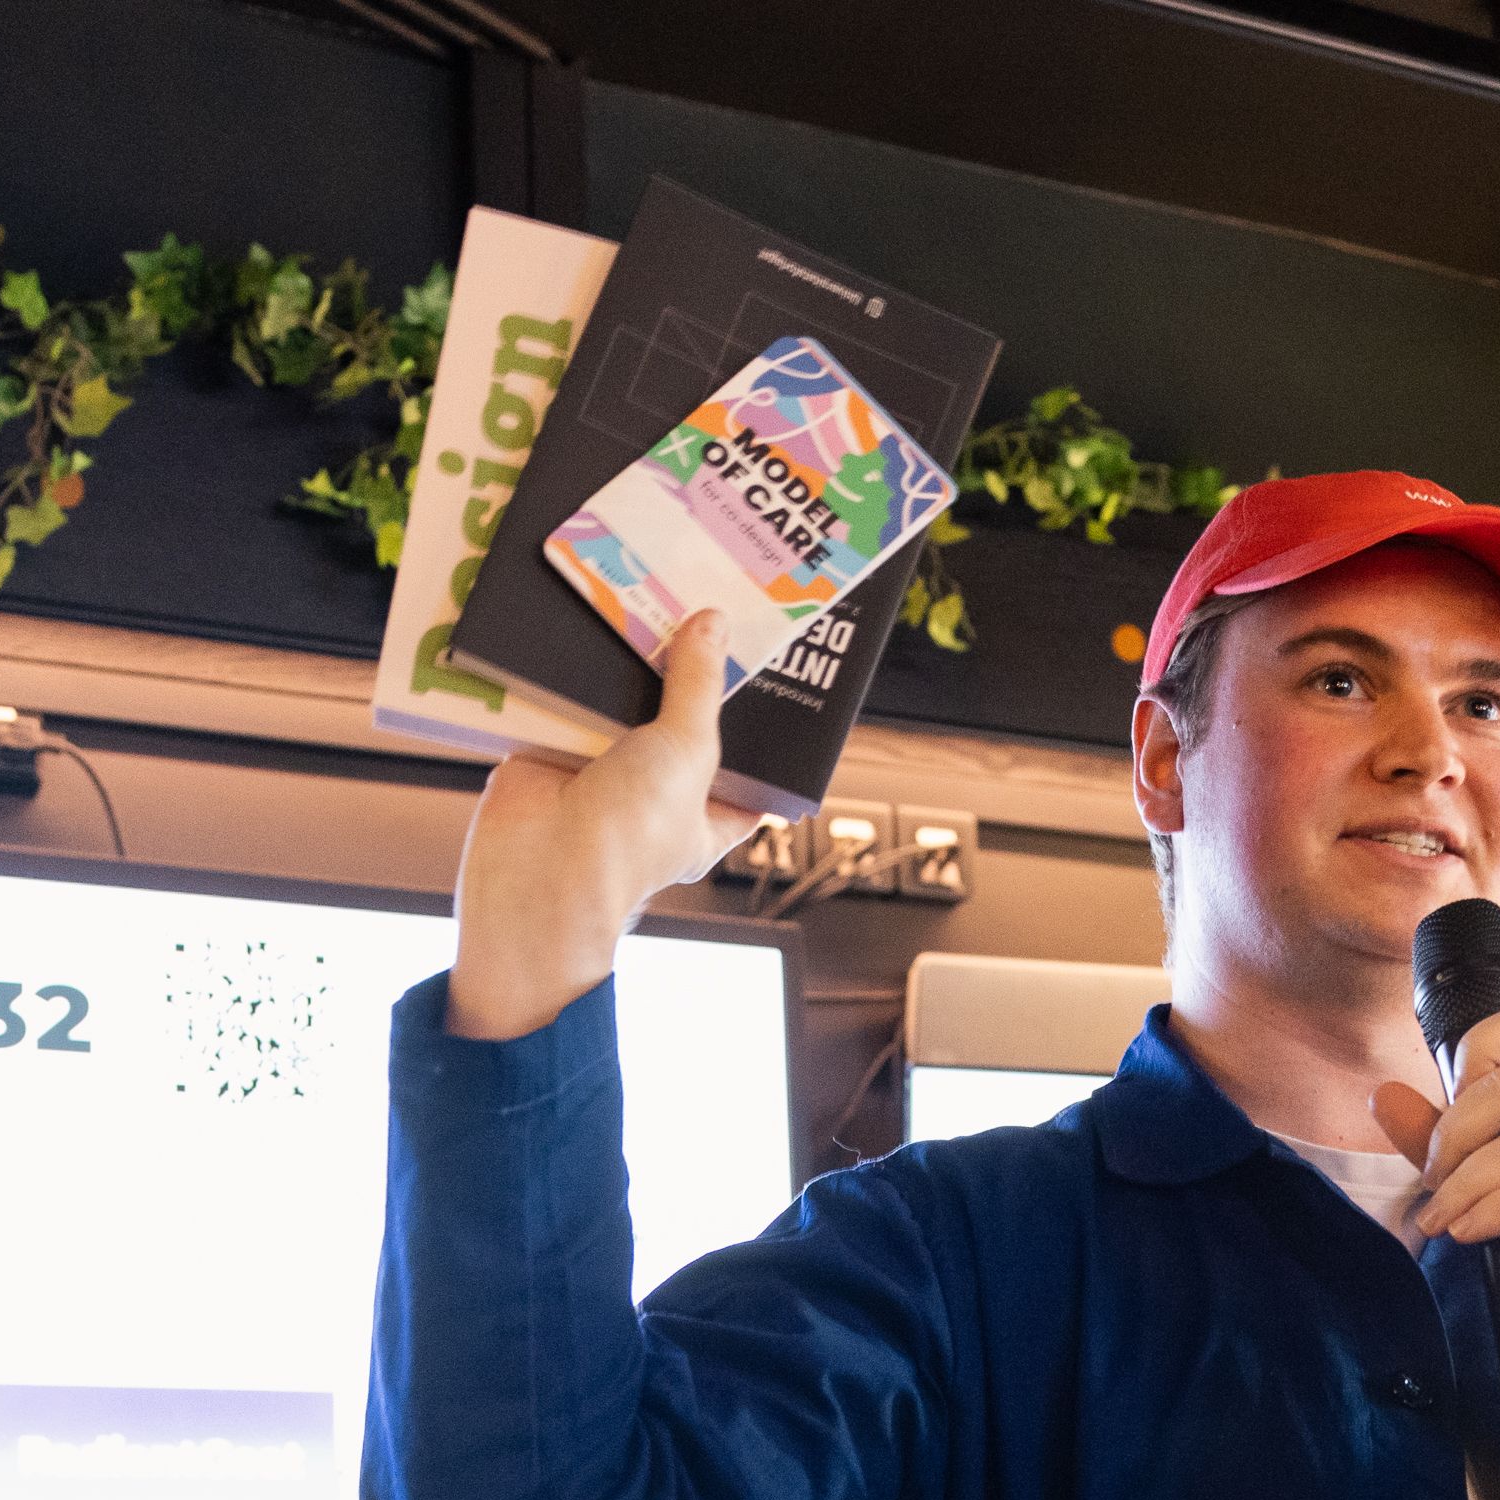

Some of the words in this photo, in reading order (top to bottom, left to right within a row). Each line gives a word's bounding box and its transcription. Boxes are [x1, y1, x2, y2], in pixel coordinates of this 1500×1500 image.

[700, 480, 720, 501] for
[701, 441, 750, 480] OF
[744, 484, 832, 571] CARE
[732, 427, 840, 540] MODEL
[804, 612, 857, 655] DE
